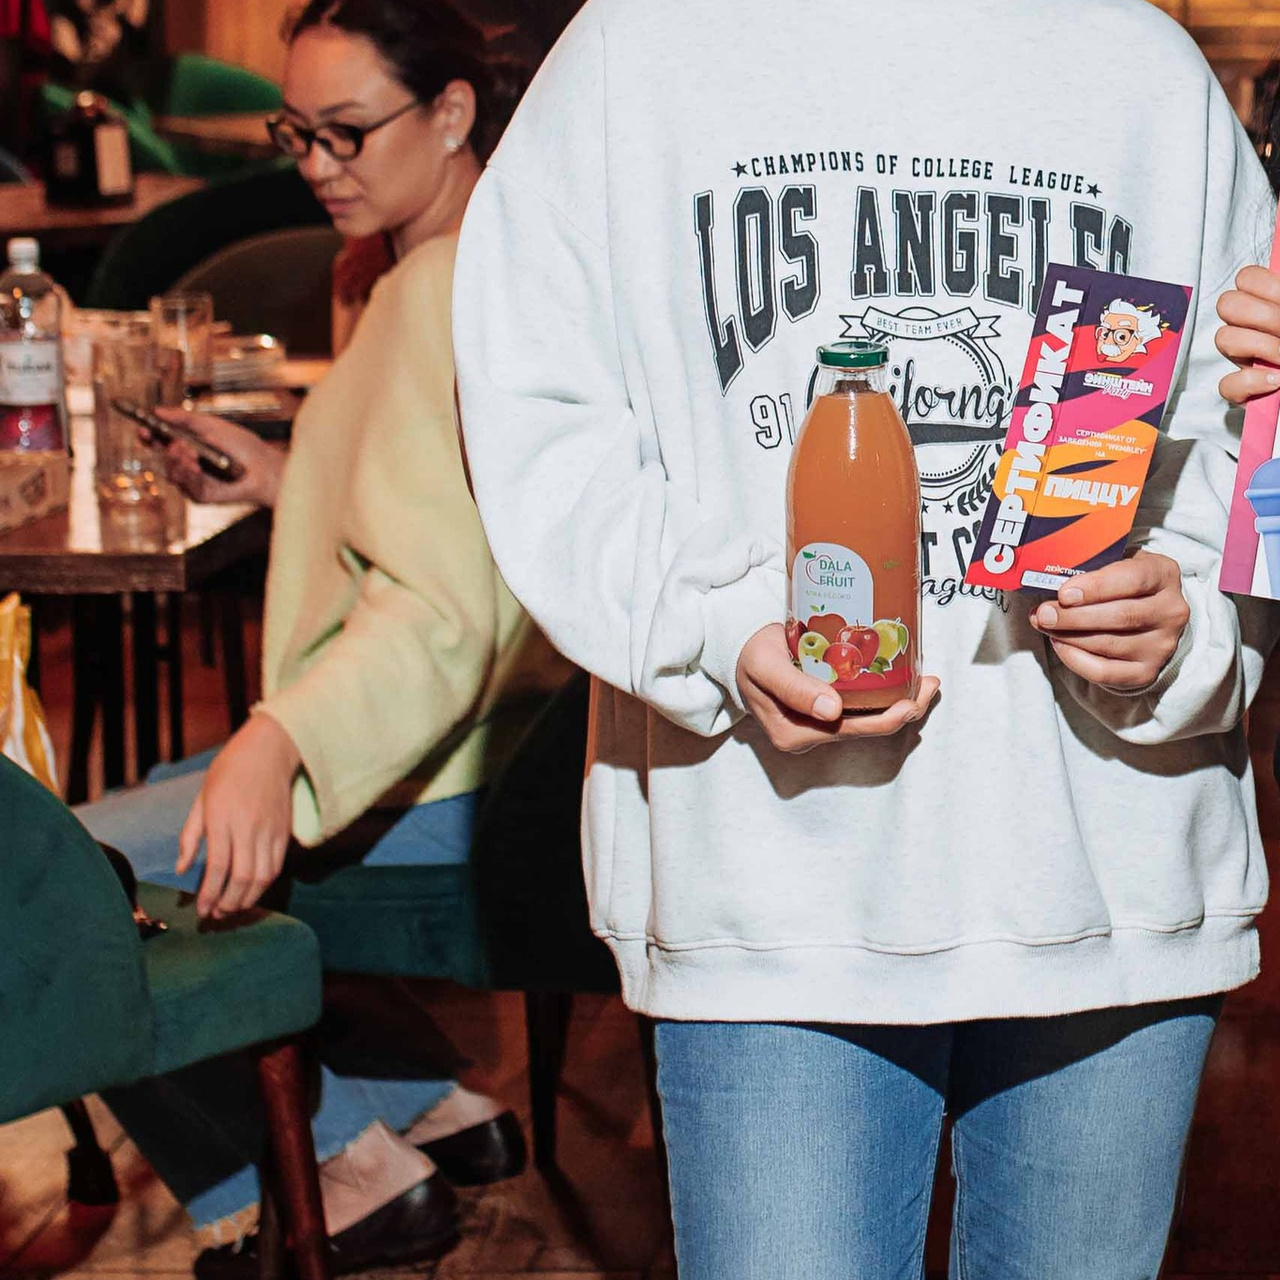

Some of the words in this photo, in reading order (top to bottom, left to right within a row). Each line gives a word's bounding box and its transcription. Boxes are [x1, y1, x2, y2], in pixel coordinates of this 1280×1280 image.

[751, 151, 865, 177] CHAMPIONS
[876, 154, 898, 175] OF
[912, 157, 993, 181] COLLEGE
[1008, 165, 1086, 195] LEAGUE
[693, 184, 822, 398] LOS
[877, 317, 899, 332] BEST
[905, 324, 932, 335] TEAM
[936, 318, 963, 332] EVER
[983, 280, 1085, 574] СЕРТИФИКАТ
[1076, 429, 1125, 442] СЕРТИФИКАТ
[1126, 436, 1137, 444] ОТ
[1043, 476, 1140, 508] ПИЦЦУ
[819, 559, 852, 572] DALA
[819, 575, 856, 587] FRUIT
